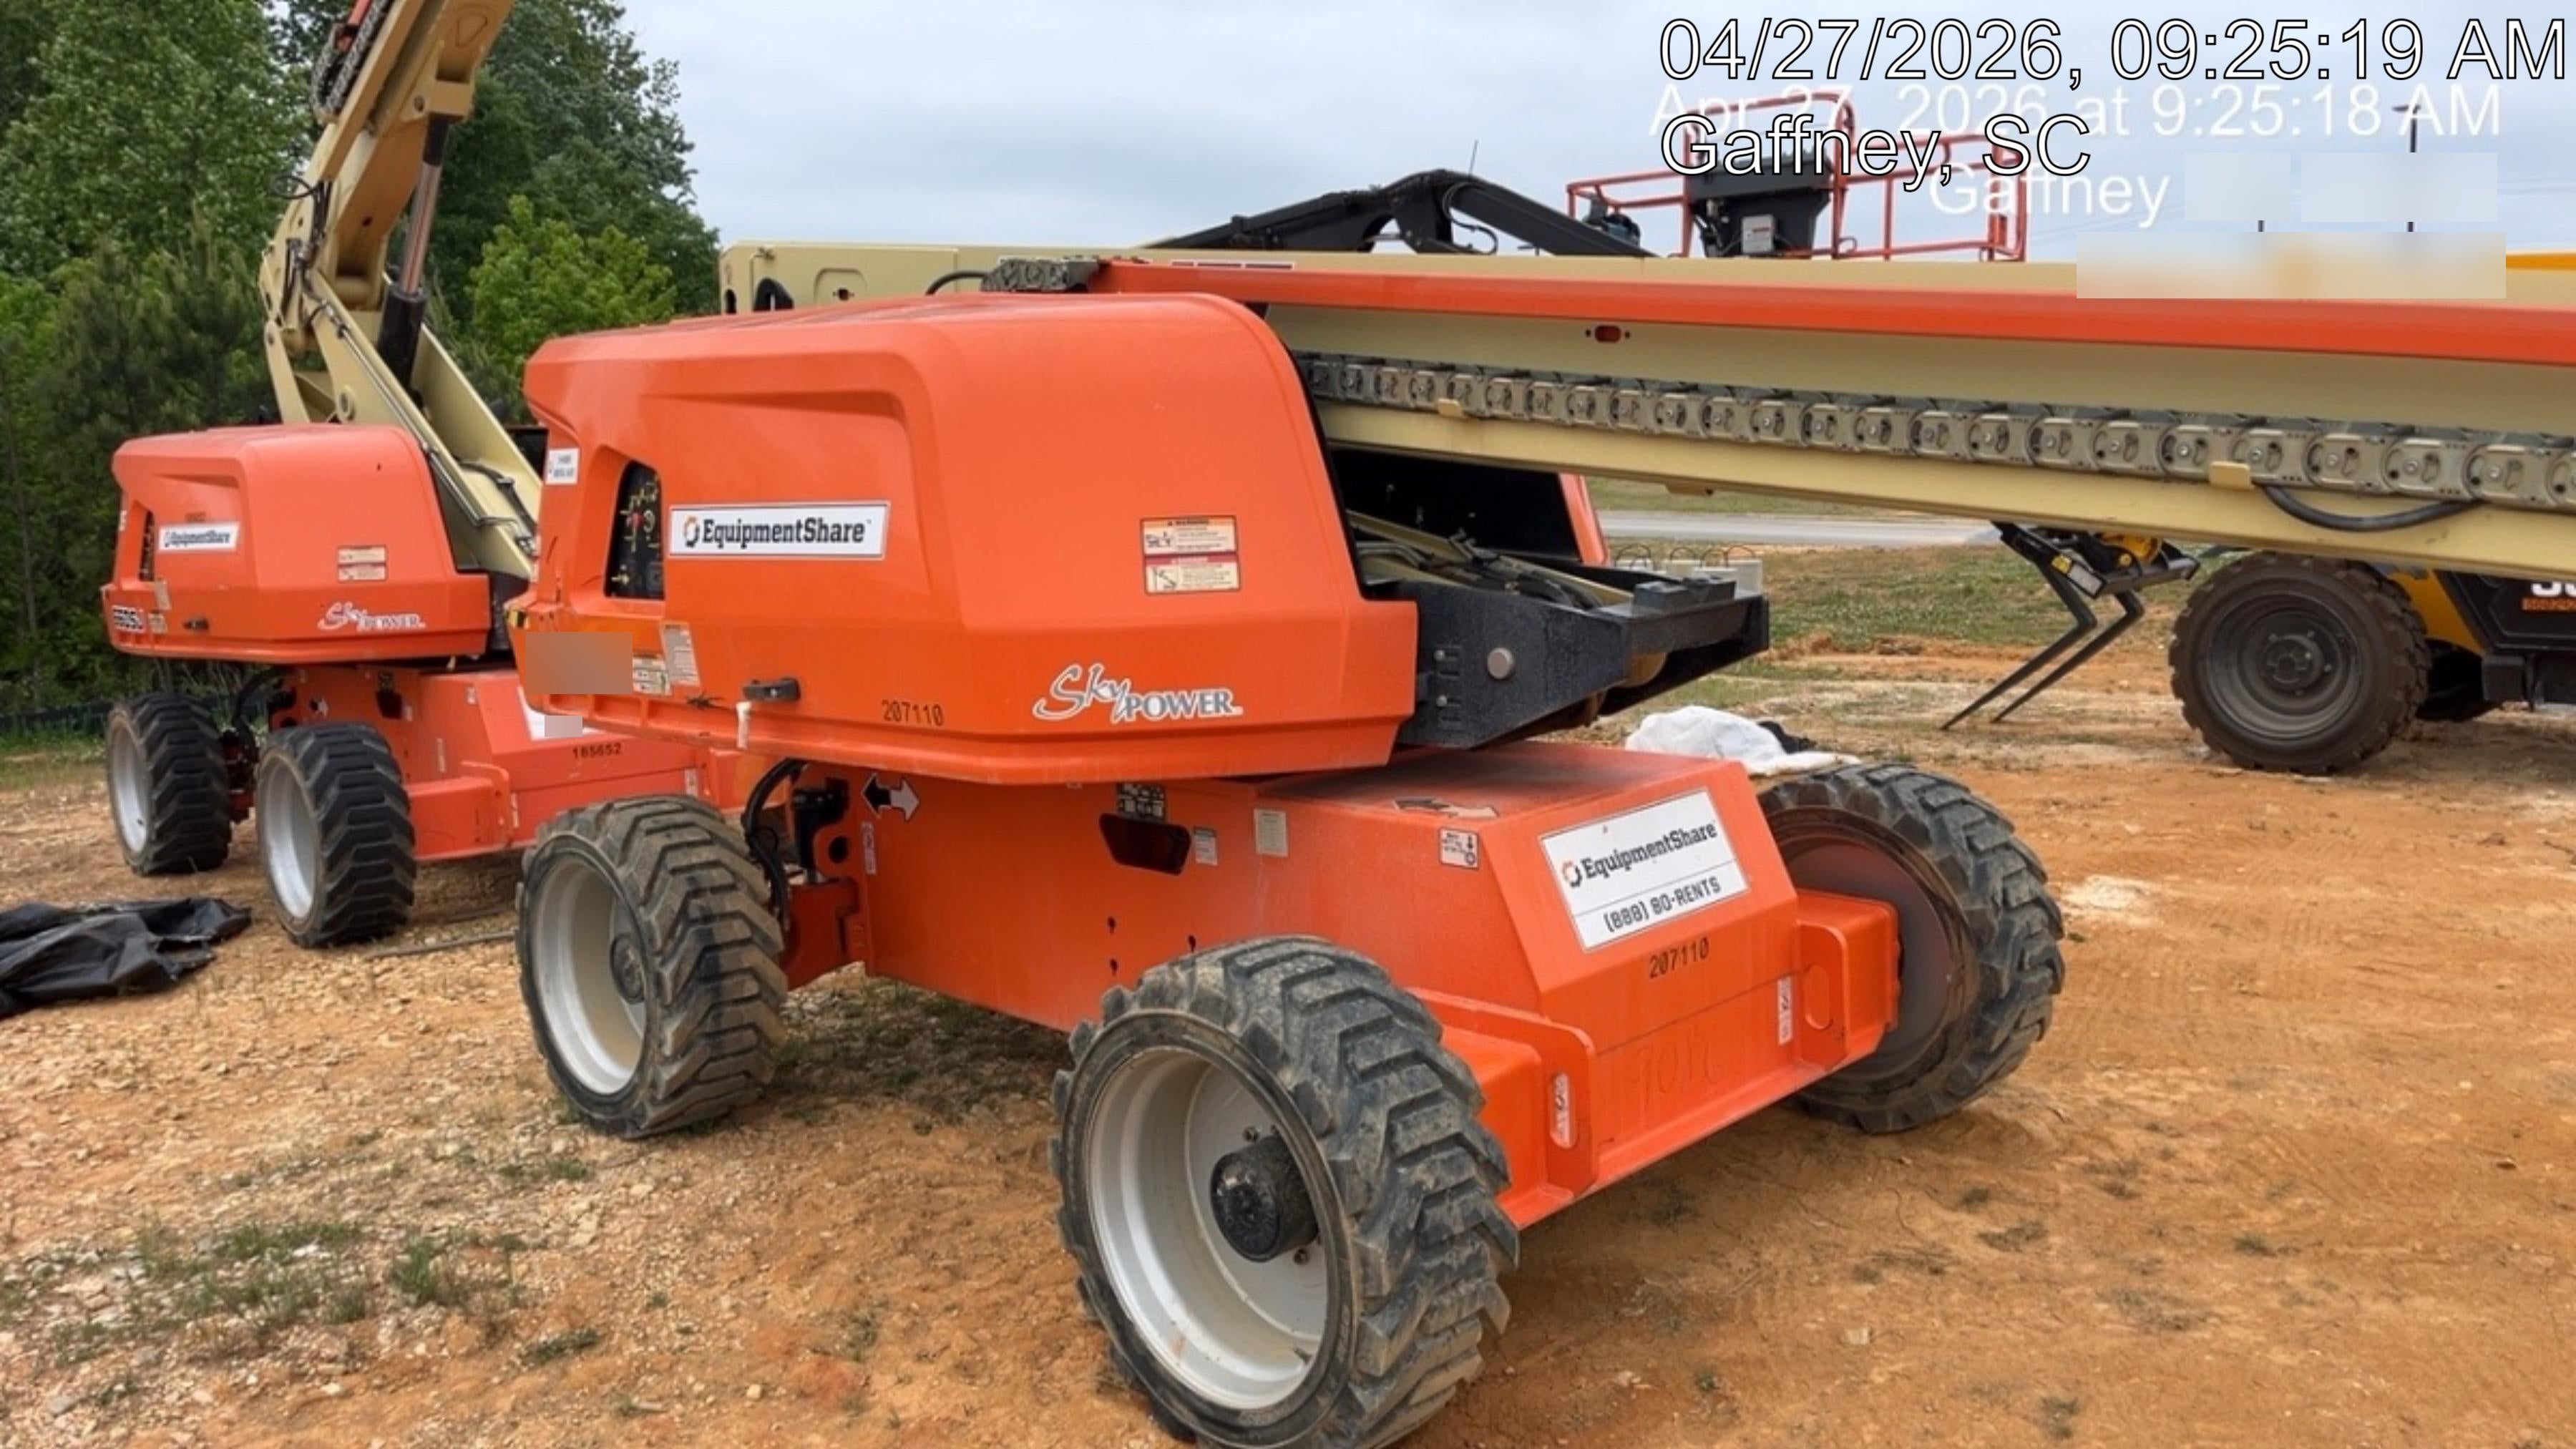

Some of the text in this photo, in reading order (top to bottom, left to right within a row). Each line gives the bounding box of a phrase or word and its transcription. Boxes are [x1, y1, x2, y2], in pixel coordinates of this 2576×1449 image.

[703, 517, 865, 549] EquipmentShare
[882, 699, 944, 726] 207110
[1580, 823, 1717, 879] EquipmentShare
[1604, 901, 1649, 932] (888)
[1649, 937, 1710, 979] 207110
